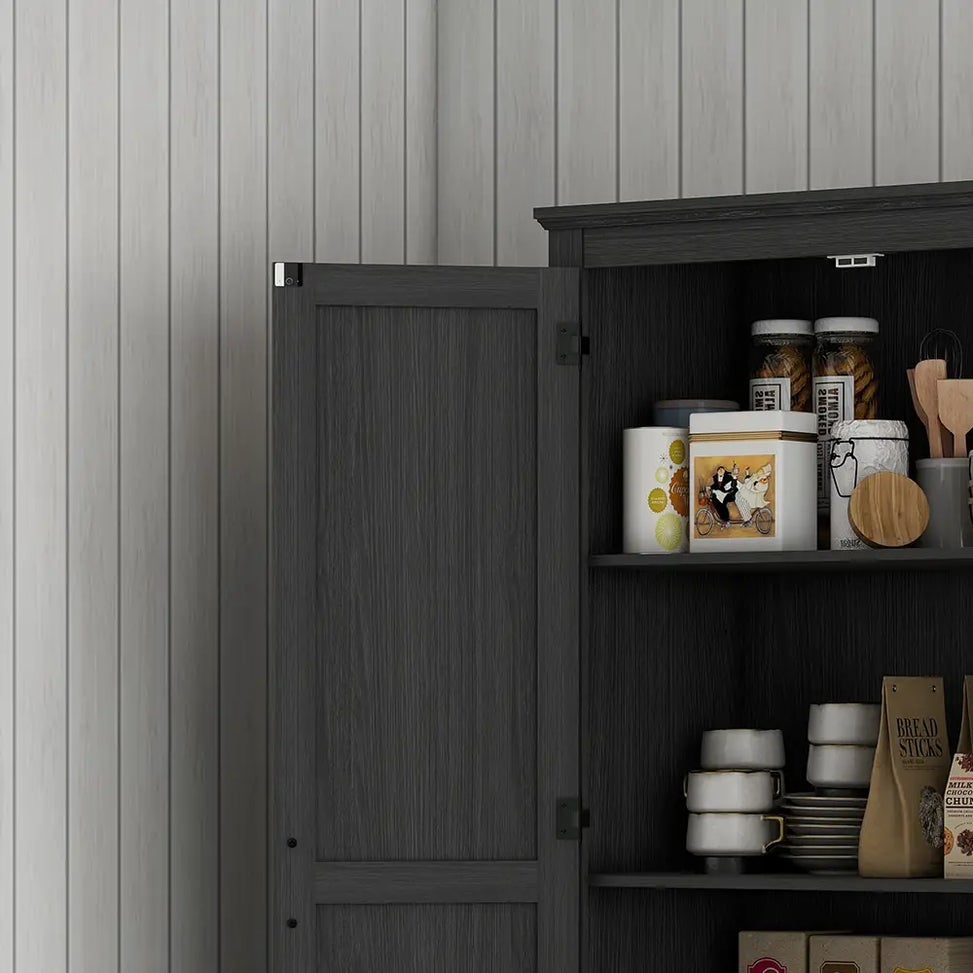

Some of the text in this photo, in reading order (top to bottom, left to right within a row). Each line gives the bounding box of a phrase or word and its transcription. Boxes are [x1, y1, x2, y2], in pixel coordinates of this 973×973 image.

[896, 718, 938, 738] BREAD
[899, 736, 943, 758] STICKS
[948, 781, 973, 789] MILK
